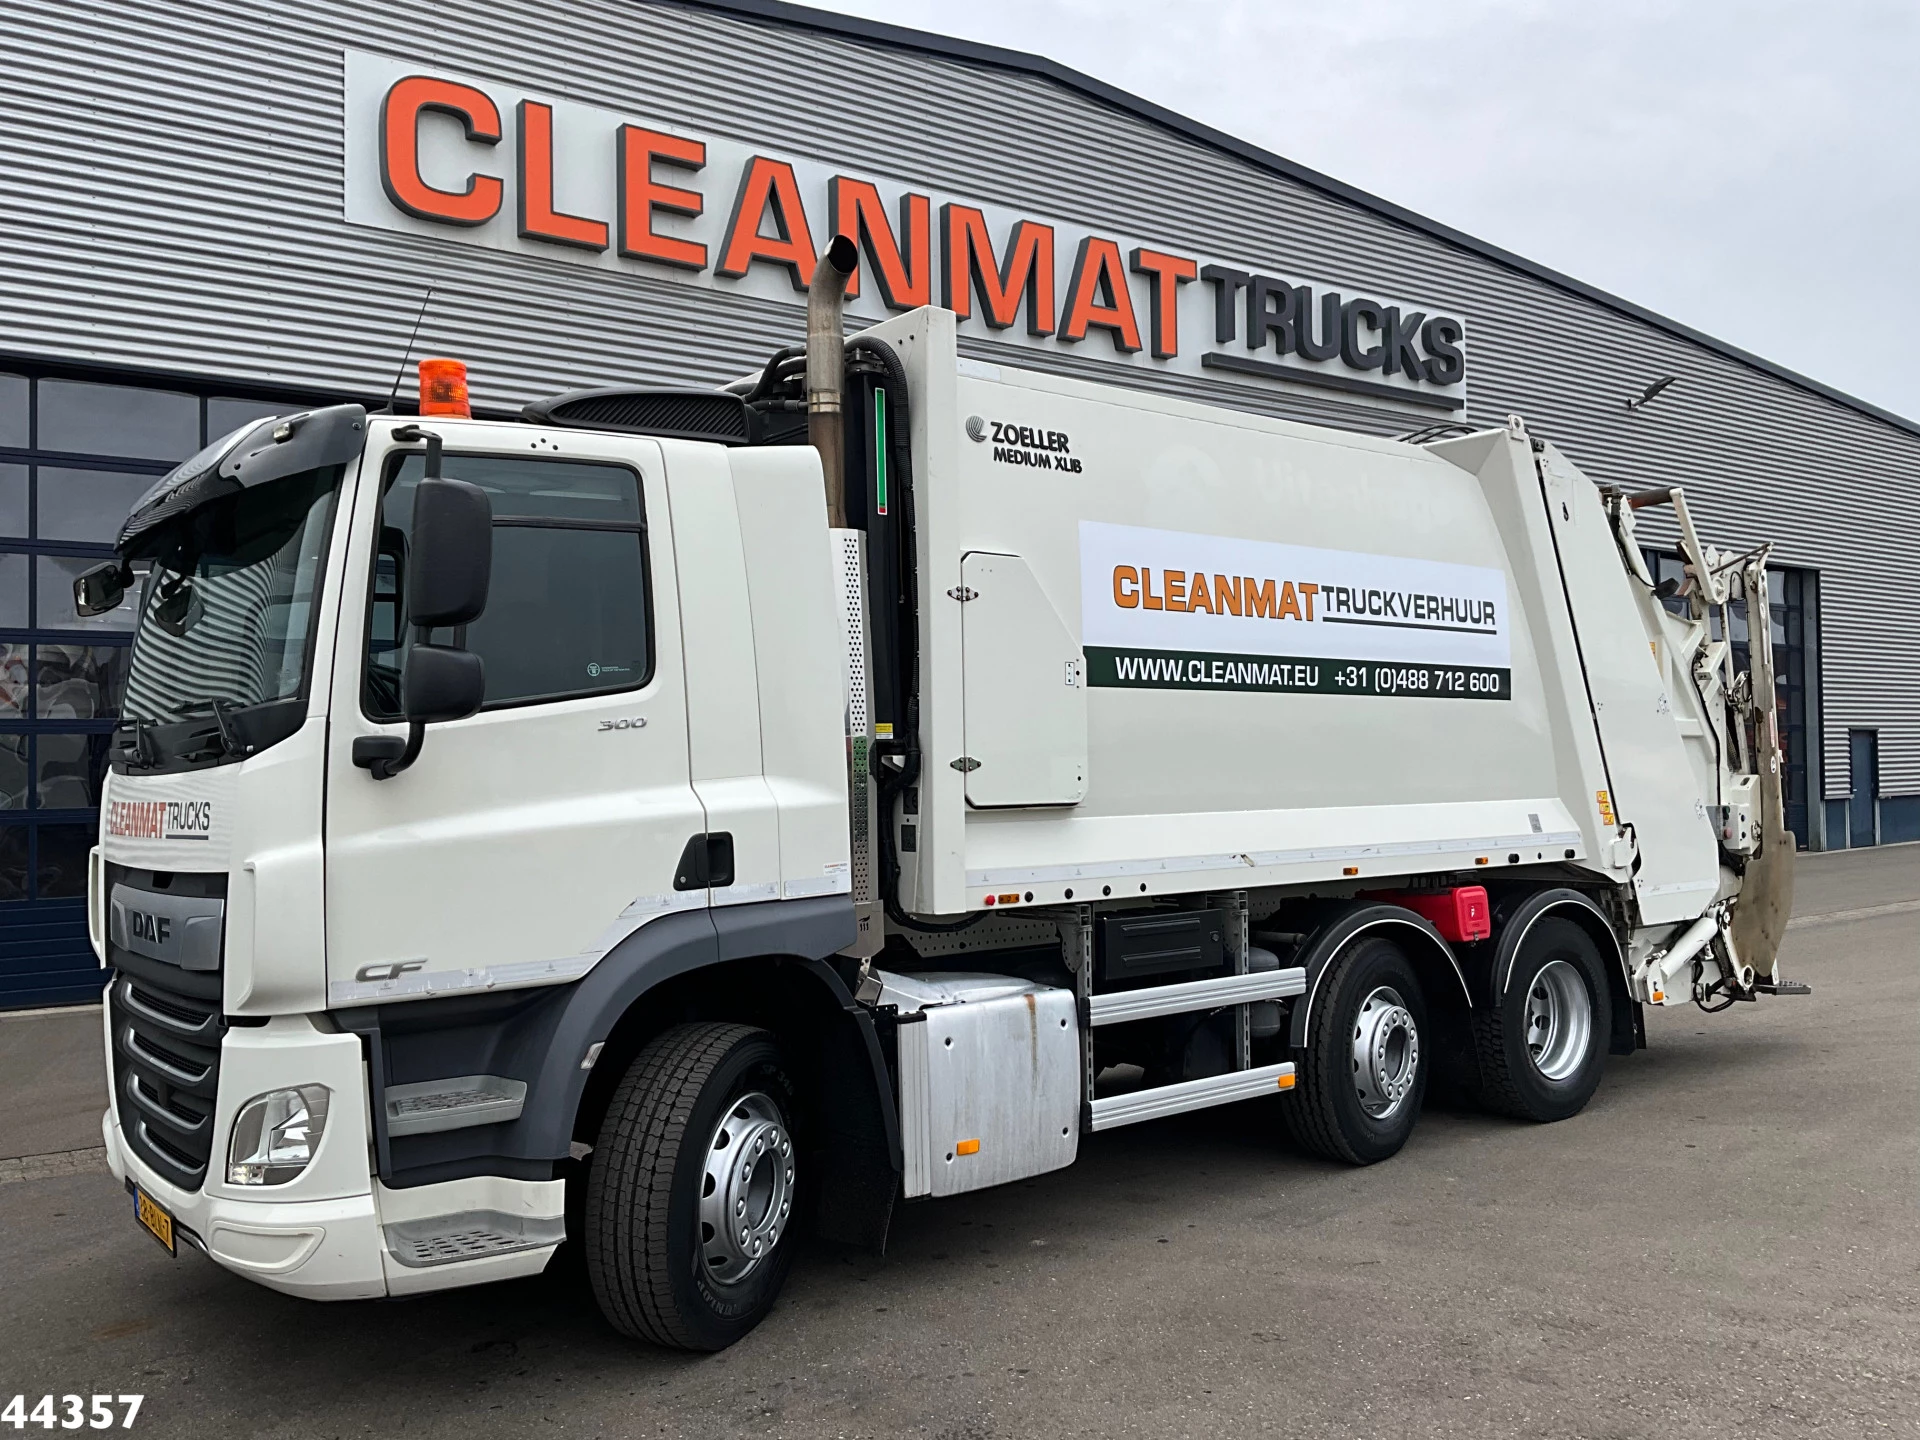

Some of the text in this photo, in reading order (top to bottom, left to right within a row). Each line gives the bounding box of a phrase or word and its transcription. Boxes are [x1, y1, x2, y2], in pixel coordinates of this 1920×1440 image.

[379, 74, 1465, 387] CLEANMAT TRUCKS
[990, 421, 1070, 454] ZOELLER
[993, 446, 1083, 474] MEDIUM XLIB
[1112, 565, 1496, 625] CLEANMAT TRUCKVERHUUR
[1115, 656, 1500, 693] WWW.CLEANMAT.EU +31 (0)488 712 600
[597, 717, 648, 732] 300
[110, 801, 211, 839] CLEANMAT TRUCKS
[132, 910, 171, 944] DAF
[355, 958, 429, 983] CF
